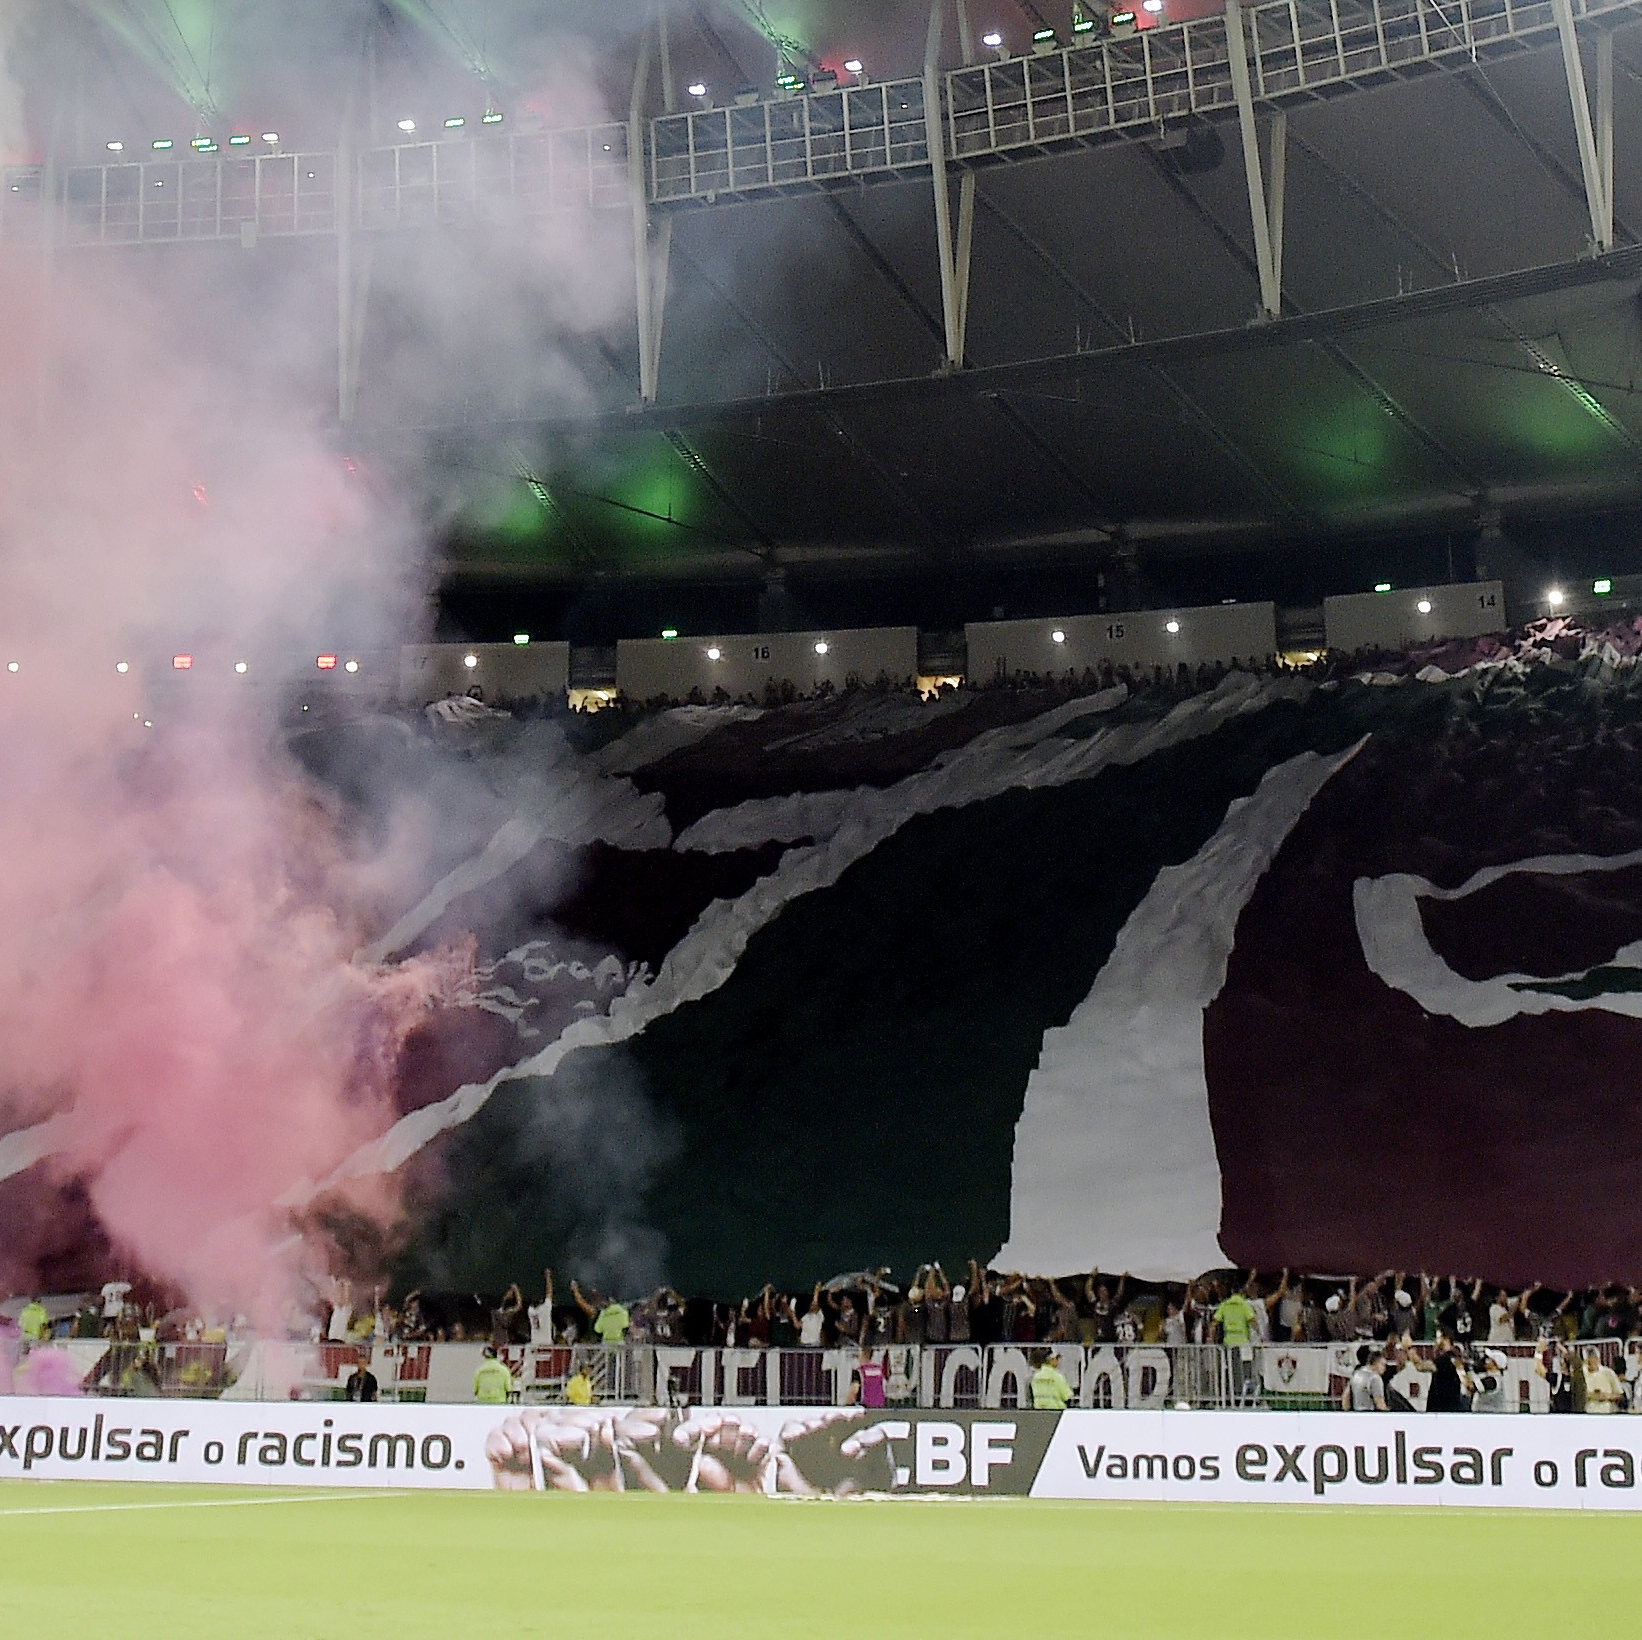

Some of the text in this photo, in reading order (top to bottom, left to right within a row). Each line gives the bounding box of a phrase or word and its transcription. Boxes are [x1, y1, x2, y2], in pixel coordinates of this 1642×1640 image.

[1478, 595, 1496, 609] 14
[1107, 625, 1124, 639] 15
[754, 646, 770, 659] 16
[203, 1441, 224, 1465] o
[237, 1418, 465, 1470] racismo.
[1077, 1444, 1220, 1481] Vamos
[1235, 1431, 1514, 1496] expulsar
[1533, 1460, 1559, 1488] o
